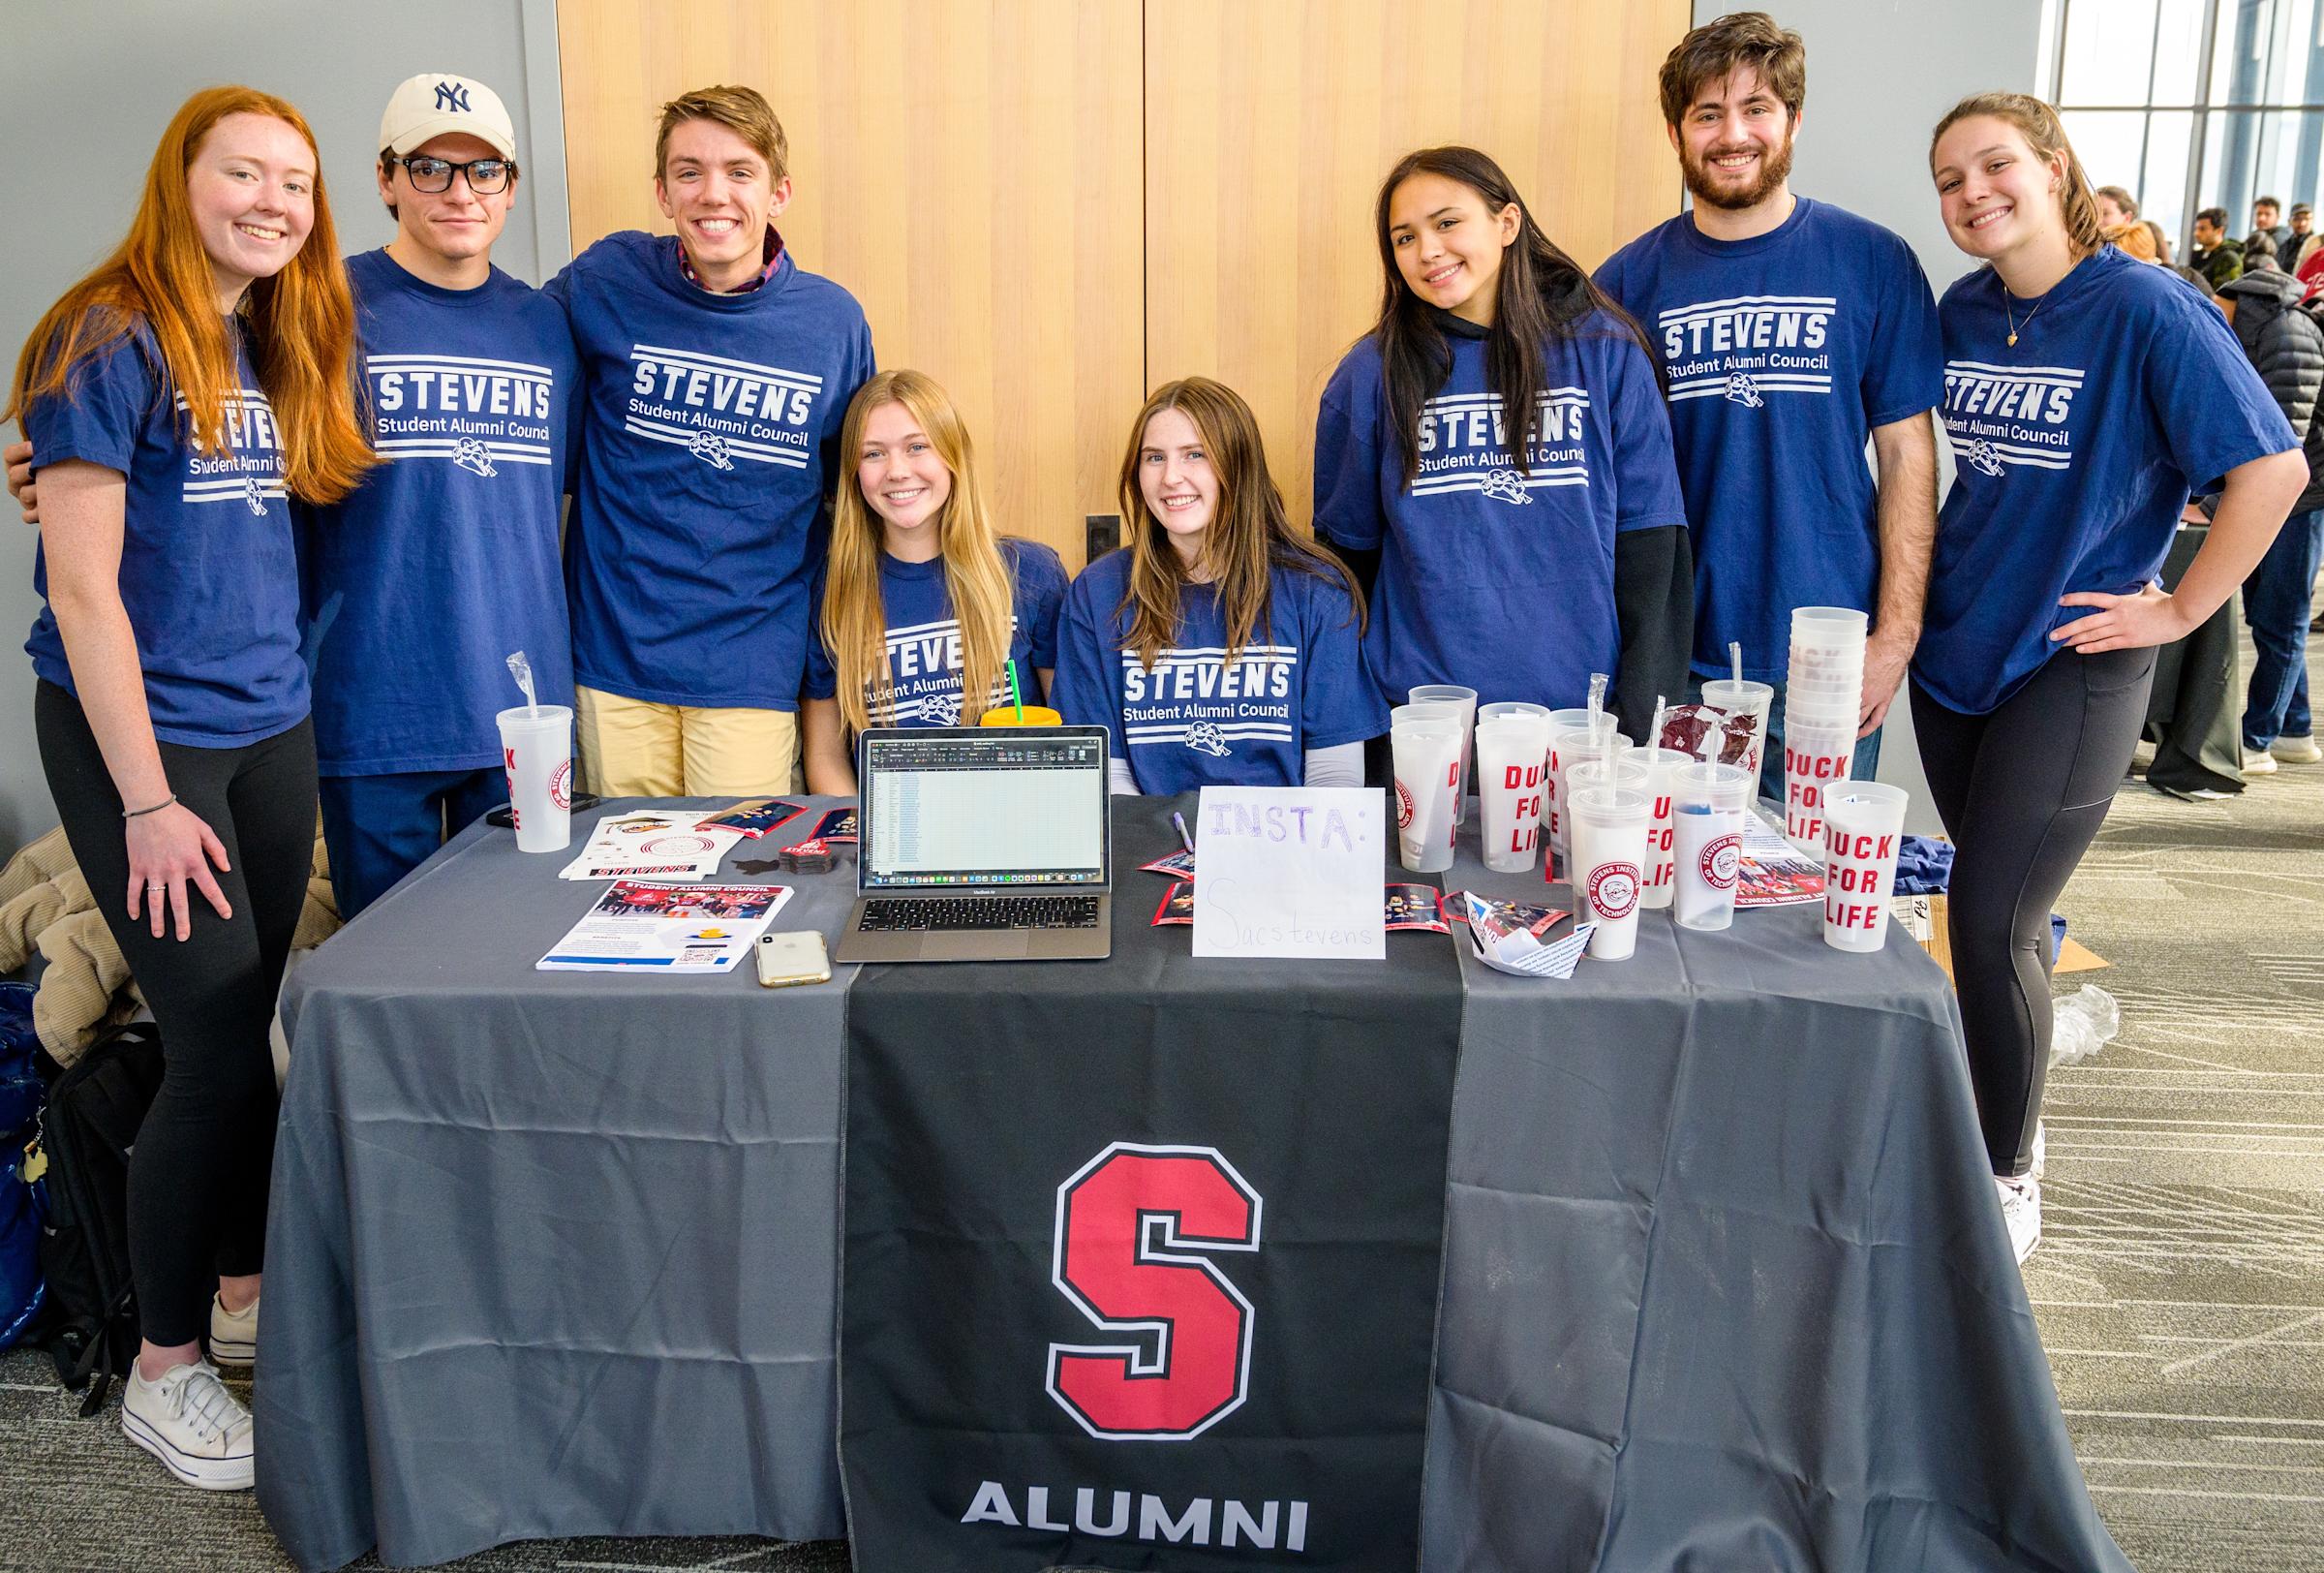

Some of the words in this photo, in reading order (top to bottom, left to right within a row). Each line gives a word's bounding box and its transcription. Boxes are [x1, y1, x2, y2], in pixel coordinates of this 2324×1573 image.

[434, 81, 472, 112] NY
[1665, 313, 1828, 360] STEVENS
[1667, 358, 1720, 379] Student
[1724, 354, 1766, 370] Alumni
[1769, 353, 1829, 370] Council
[379, 372, 550, 420] STEVENS
[633, 360, 812, 426] STEVENS
[1944, 375, 2074, 424] STEVENS
[378, 416, 446, 434] Student
[450, 417, 505, 436] Alumni
[628, 398, 688, 423] Student
[690, 412, 748, 435] Alumni
[750, 423, 809, 447] Council
[1969, 420, 2009, 438] Alumni
[2010, 425, 2069, 446] Council
[1419, 453, 1474, 473] Student
[865, 684, 909, 704] tudent
[913, 674, 963, 694] Alumni
[1124, 663, 1290, 701] STEVENS
[1123, 706, 1180, 722] Student
[1183, 703, 1235, 719] Alumni
[1238, 702, 1289, 719] Council
[1786, 748, 1849, 779] DUCK
[1515, 795, 1540, 819] FO
[1790, 783, 1823, 808] FO
[1208, 803, 1366, 853] INSTA:
[1647, 829, 1673, 851] FO
[1789, 812, 1824, 841] LIF
[1703, 840, 1728, 865] STEVENS
[1825, 823, 1893, 860] DUCK
[597, 865, 689, 877] STEVENS
[1590, 866, 1615, 891] STEVENS
[1705, 869, 1713, 879] OF
[1828, 861, 1879, 893] FOR
[626, 881, 678, 891] STUDENT
[1592, 896, 1601, 905] OF
[1599, 894, 1636, 917] TECHNOLOGY
[1825, 897, 1879, 930] LIFE
[1046, 1141, 1264, 1440] S
[960, 1480, 1308, 1552] ALUMNI
